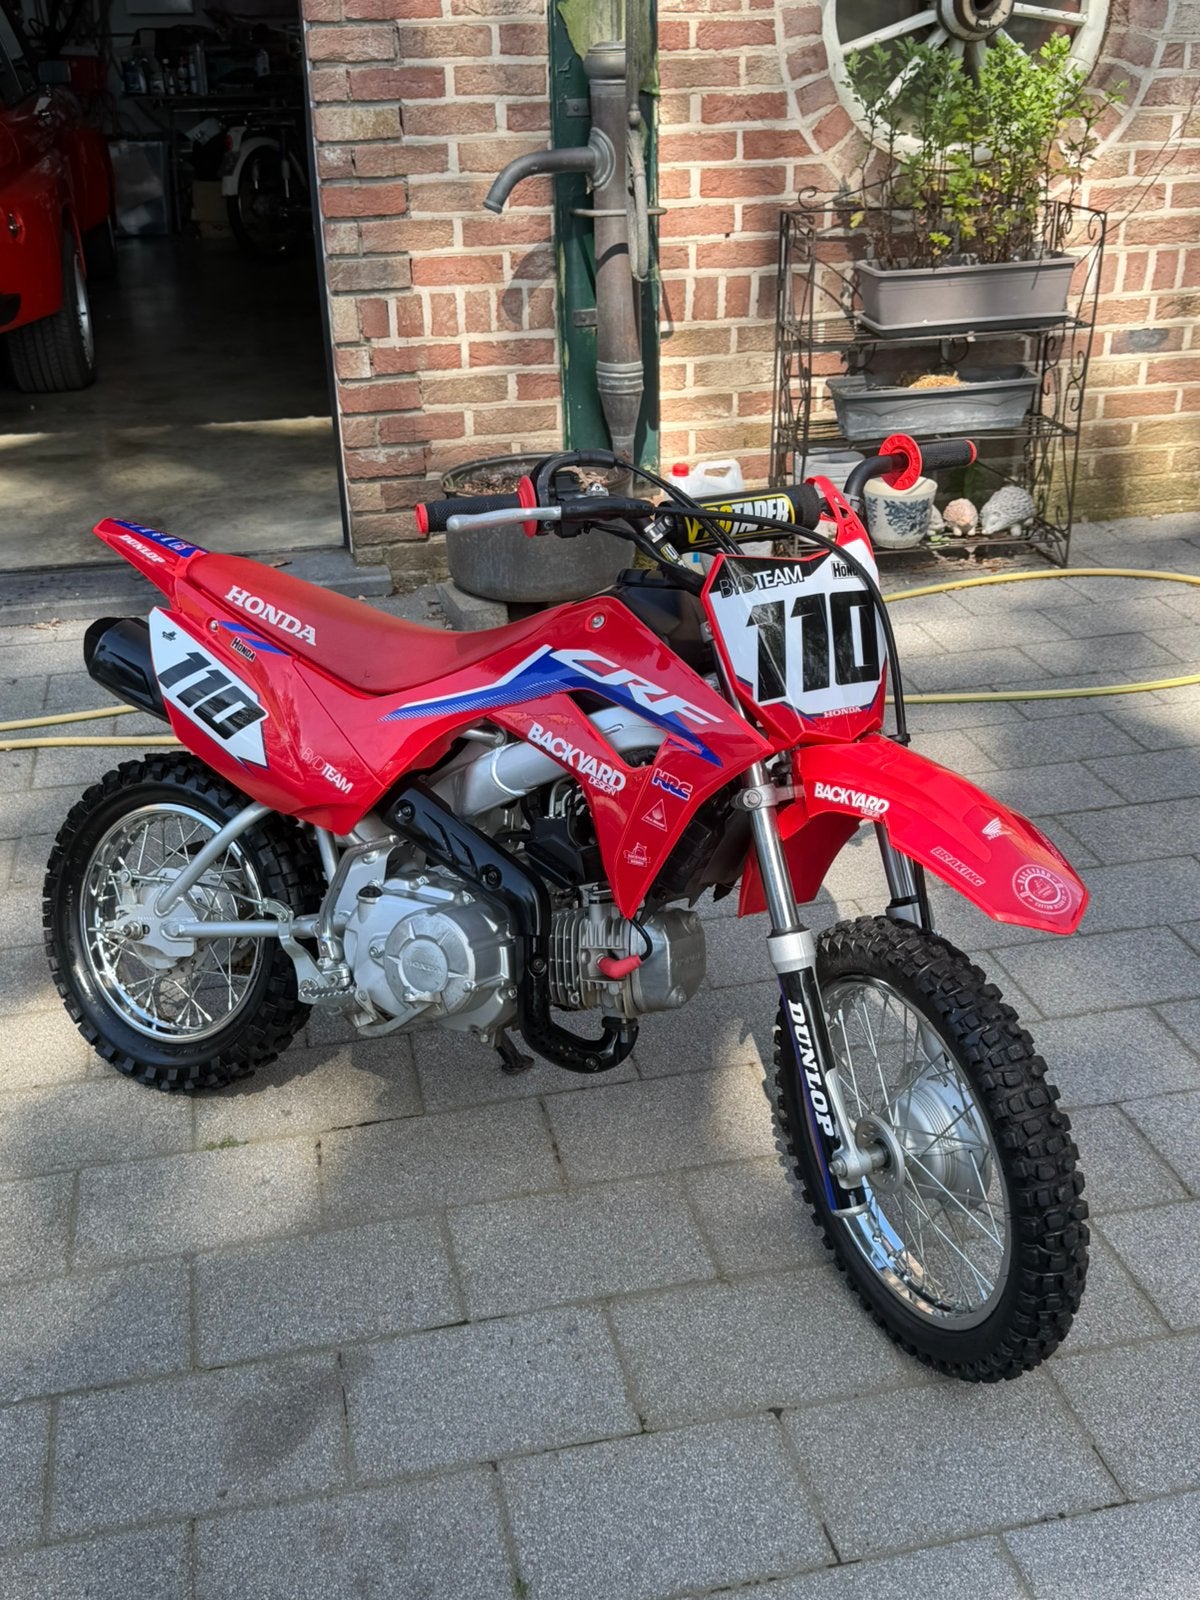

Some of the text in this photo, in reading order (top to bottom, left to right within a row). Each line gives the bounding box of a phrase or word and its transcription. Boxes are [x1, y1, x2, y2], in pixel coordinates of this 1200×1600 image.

[118, 534, 166, 563] DUNLOP
[224, 585, 317, 646] HONDA
[746, 590, 880, 702] 110
[157, 651, 268, 740] 110
[549, 649, 724, 725] CRF
[823, 706, 862, 719] HONDA
[527, 720, 627, 791] BACKYARD
[588, 776, 618, 796] DESIGN
[651, 767, 693, 801] HRC
[814, 781, 890, 814] BACKYARD
[932, 846, 986, 887] BRAKING
[788, 999, 835, 1138] DUNLOP
